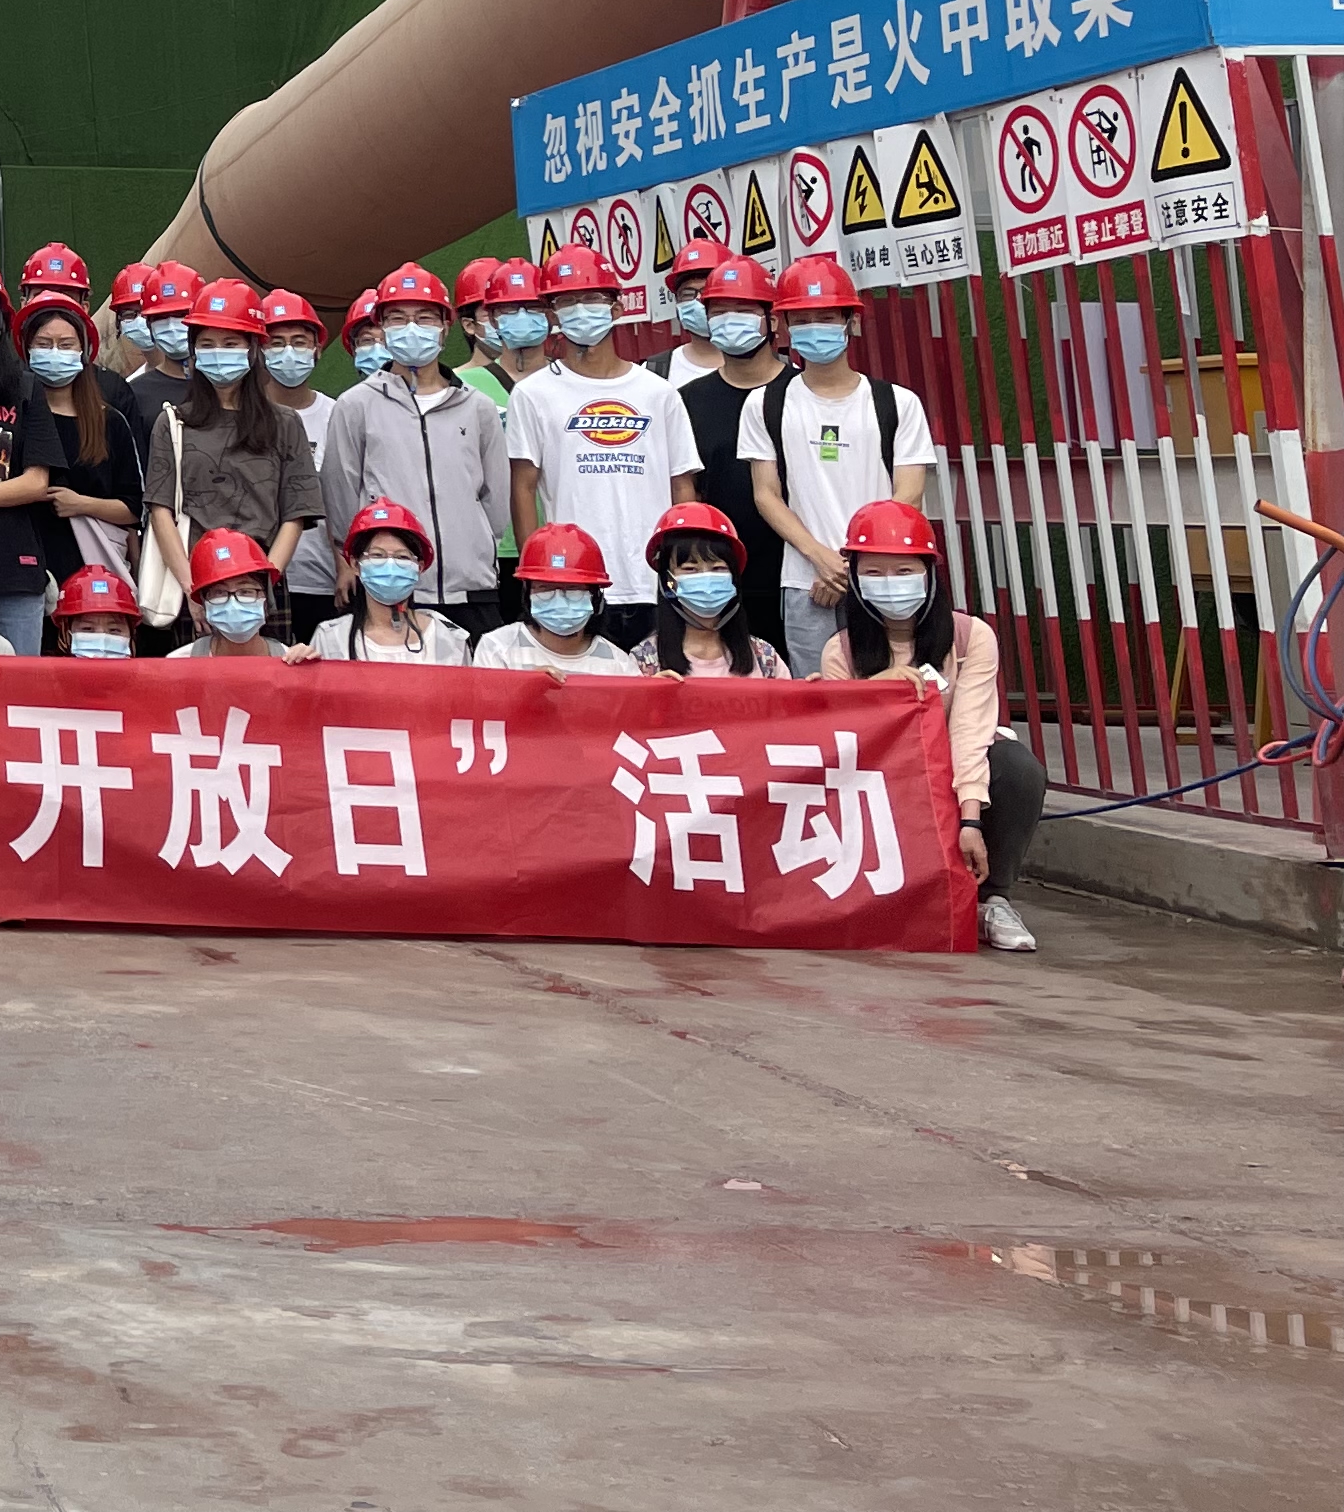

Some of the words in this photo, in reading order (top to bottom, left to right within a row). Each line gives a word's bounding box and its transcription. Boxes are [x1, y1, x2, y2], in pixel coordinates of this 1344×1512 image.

[1161, 192, 1230, 229] 注意安全
[1012, 223, 1065, 259] 请勿靠近
[1082, 208, 1145, 246] 禁止攀登
[849, 244, 891, 272] 当心触电
[904, 236, 964, 270] 当心坠落
[574, 416, 645, 429] Dickies
[576, 452, 645, 464] SATISFACTION
[578, 464, 645, 475] GUARANTEED
